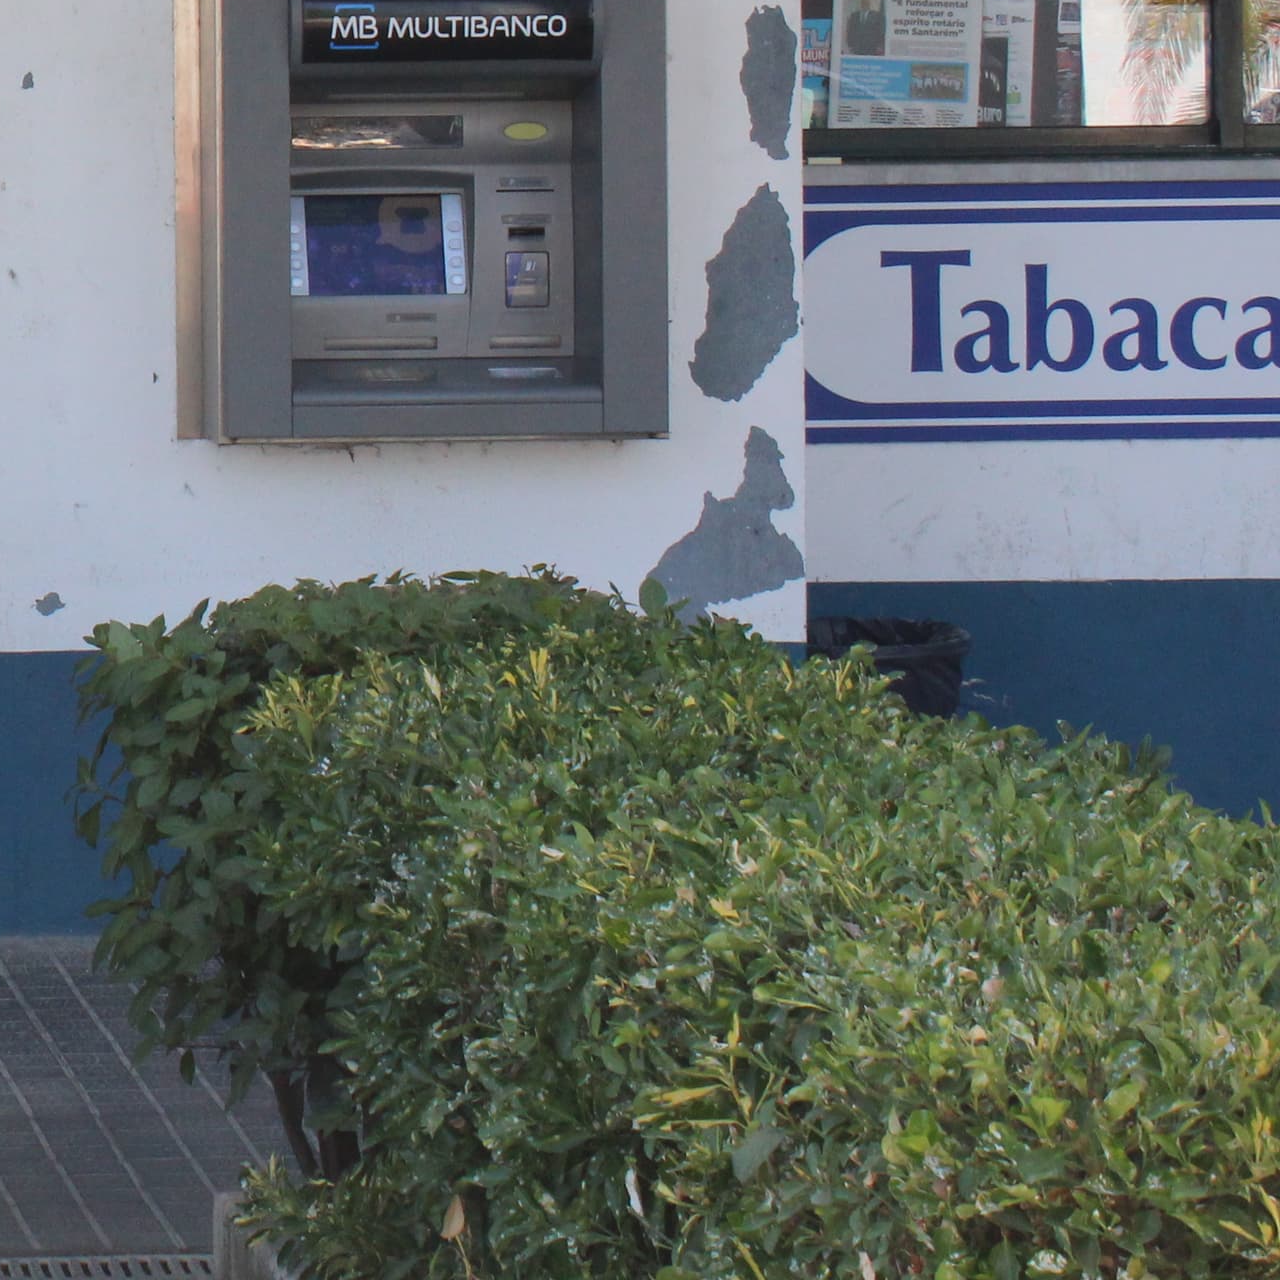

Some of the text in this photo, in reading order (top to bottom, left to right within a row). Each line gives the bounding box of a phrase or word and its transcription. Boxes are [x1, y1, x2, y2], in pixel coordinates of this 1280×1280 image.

[330, 14, 567, 40] MB MULTIBANCO
[880, 249, 1280, 375] Tabaca
